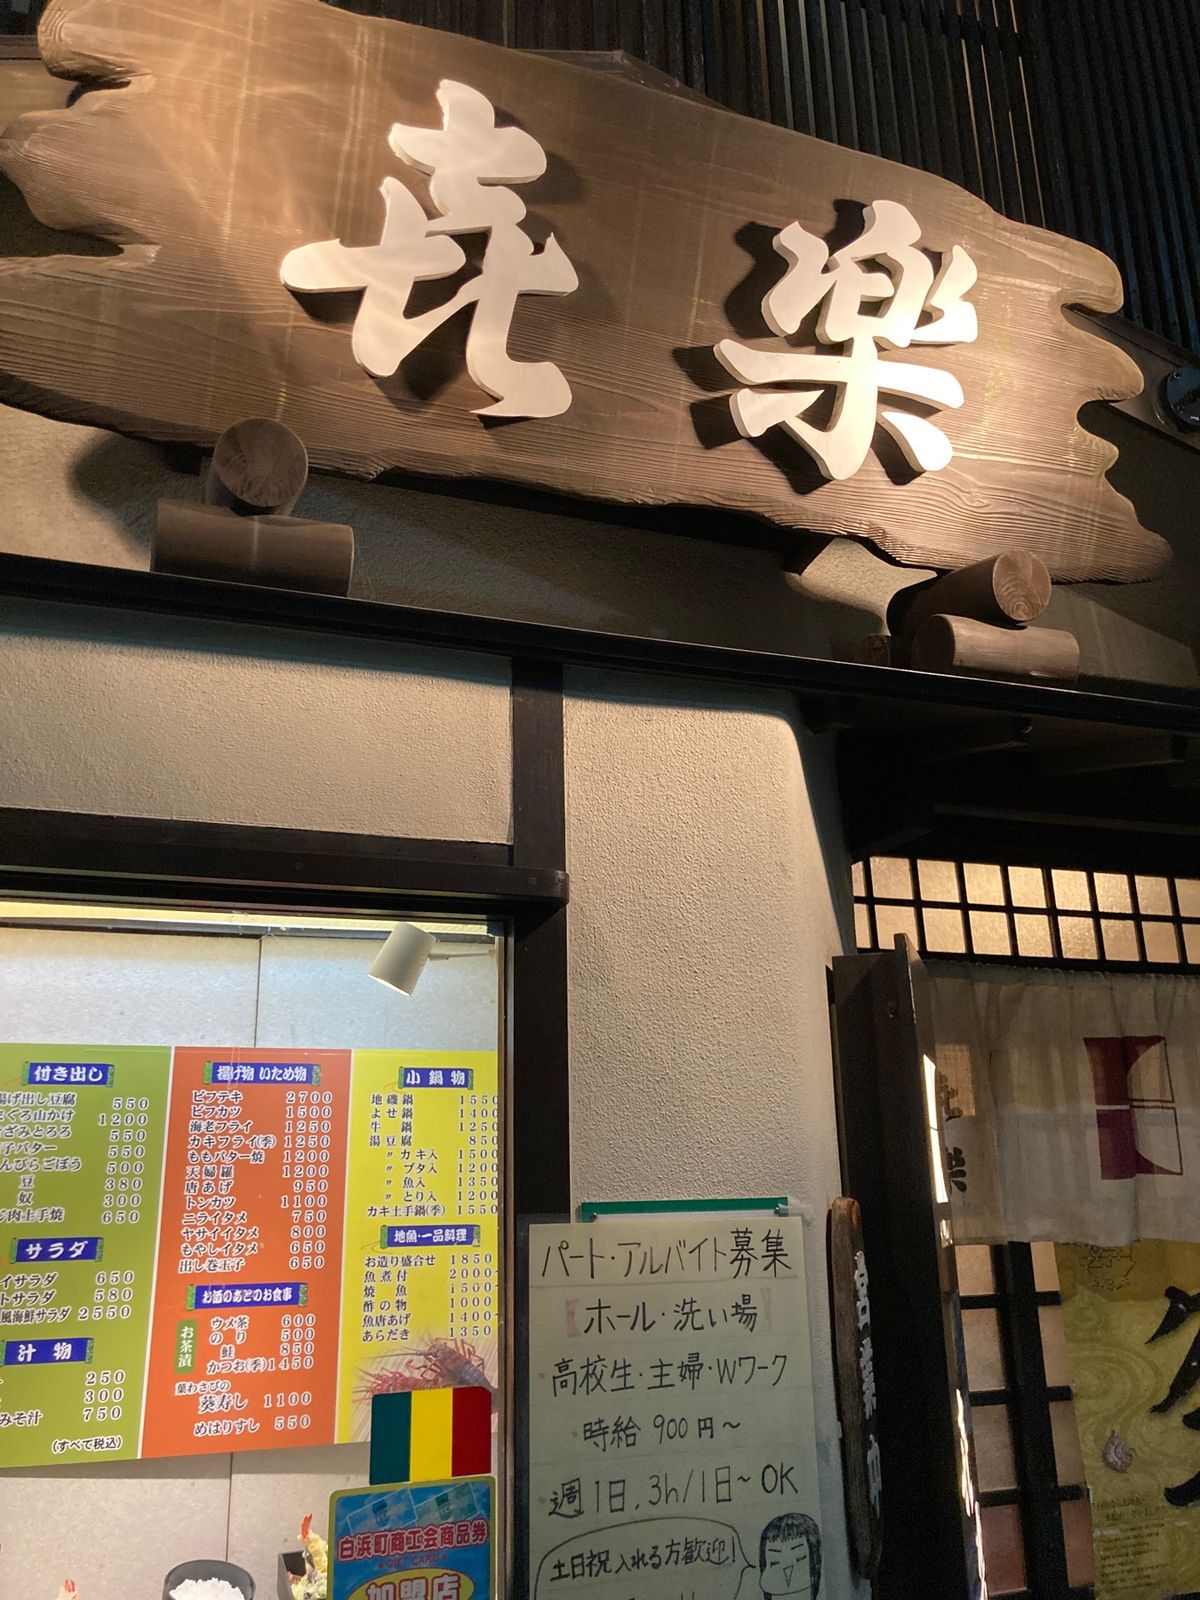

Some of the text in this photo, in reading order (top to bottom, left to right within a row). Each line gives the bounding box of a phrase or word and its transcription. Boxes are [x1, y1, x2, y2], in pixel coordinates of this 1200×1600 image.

[34, 1066, 103, 1082] 付き出し
[217, 1065, 307, 1081] 揚げ物 いため物
[406, 1070, 466, 1085] 小鍋物
[113, 1098, 148, 1110] 550
[286, 1091, 333, 1104] 2700
[459, 1094, 498, 1105] 1550
[286, 1106, 332, 1118] 1500
[459, 1108, 498, 1119] 1400
[98, 1114, 147, 1126] 1200
[189, 1120, 331, 1133] 海老フライ 1250
[459, 1121, 498, 1132] 1250
[109, 1130, 146, 1142] 550
[284, 1135, 330, 1148] 1250
[469, 1136, 498, 1146] 850
[0, 1142, 145, 1158] 子バター 550
[188, 1150, 329, 1163] ももバター焼 1200
[458, 1149, 498, 1160] 1500
[107, 1162, 143, 1174] 500
[282, 1164, 329, 1177] 1200
[458, 1163, 498, 1174] 1200
[105, 1178, 142, 1190] 380
[184, 1180, 328, 1194] 唐あげ 950
[457, 1177, 498, 1188] 1350
[104, 1194, 141, 1207] 300
[186, 1195, 327, 1209] トンカツ 1100
[457, 1190, 498, 1201] 1200
[457, 1204, 498, 1216] 1550
[102, 1211, 139, 1224] 650
[182, 1210, 326, 1225] ニライタメ 750
[181, 1225, 326, 1241] ヤサイイタメ 800
[26, 1241, 88, 1260] サラダ
[181, 1241, 325, 1256] もやしイタメ 650
[289, 1256, 324, 1269] 650
[450, 1253, 492, 1265] 1850
[96, 1271, 134, 1284] 650
[449, 1268, 492, 1280] 2000
[95, 1288, 132, 1301] 580
[449, 1282, 492, 1294] 1500
[449, 1296, 491, 1308] 1000
[78, 1306, 131, 1320] 2550
[449, 1311, 491, 1323] 1400
[281, 1313, 315, 1328] 600
[281, 1328, 315, 1342] 500
[362, 1325, 491, 1342] あらだき 1350
[280, 1342, 314, 1356] 850
[267, 1356, 313, 1371] 1450
[85, 1370, 125, 1385] 250
[84, 1389, 123, 1403] 300
[263, 1391, 312, 1408] 1100
[83, 1407, 122, 1421] 750
[193, 1415, 311, 1437] めはりすし 550
[52, 1436, 123, 1454] (すべて税込)
[337, 1519, 489, 1562] 白浜町商工会商品券
